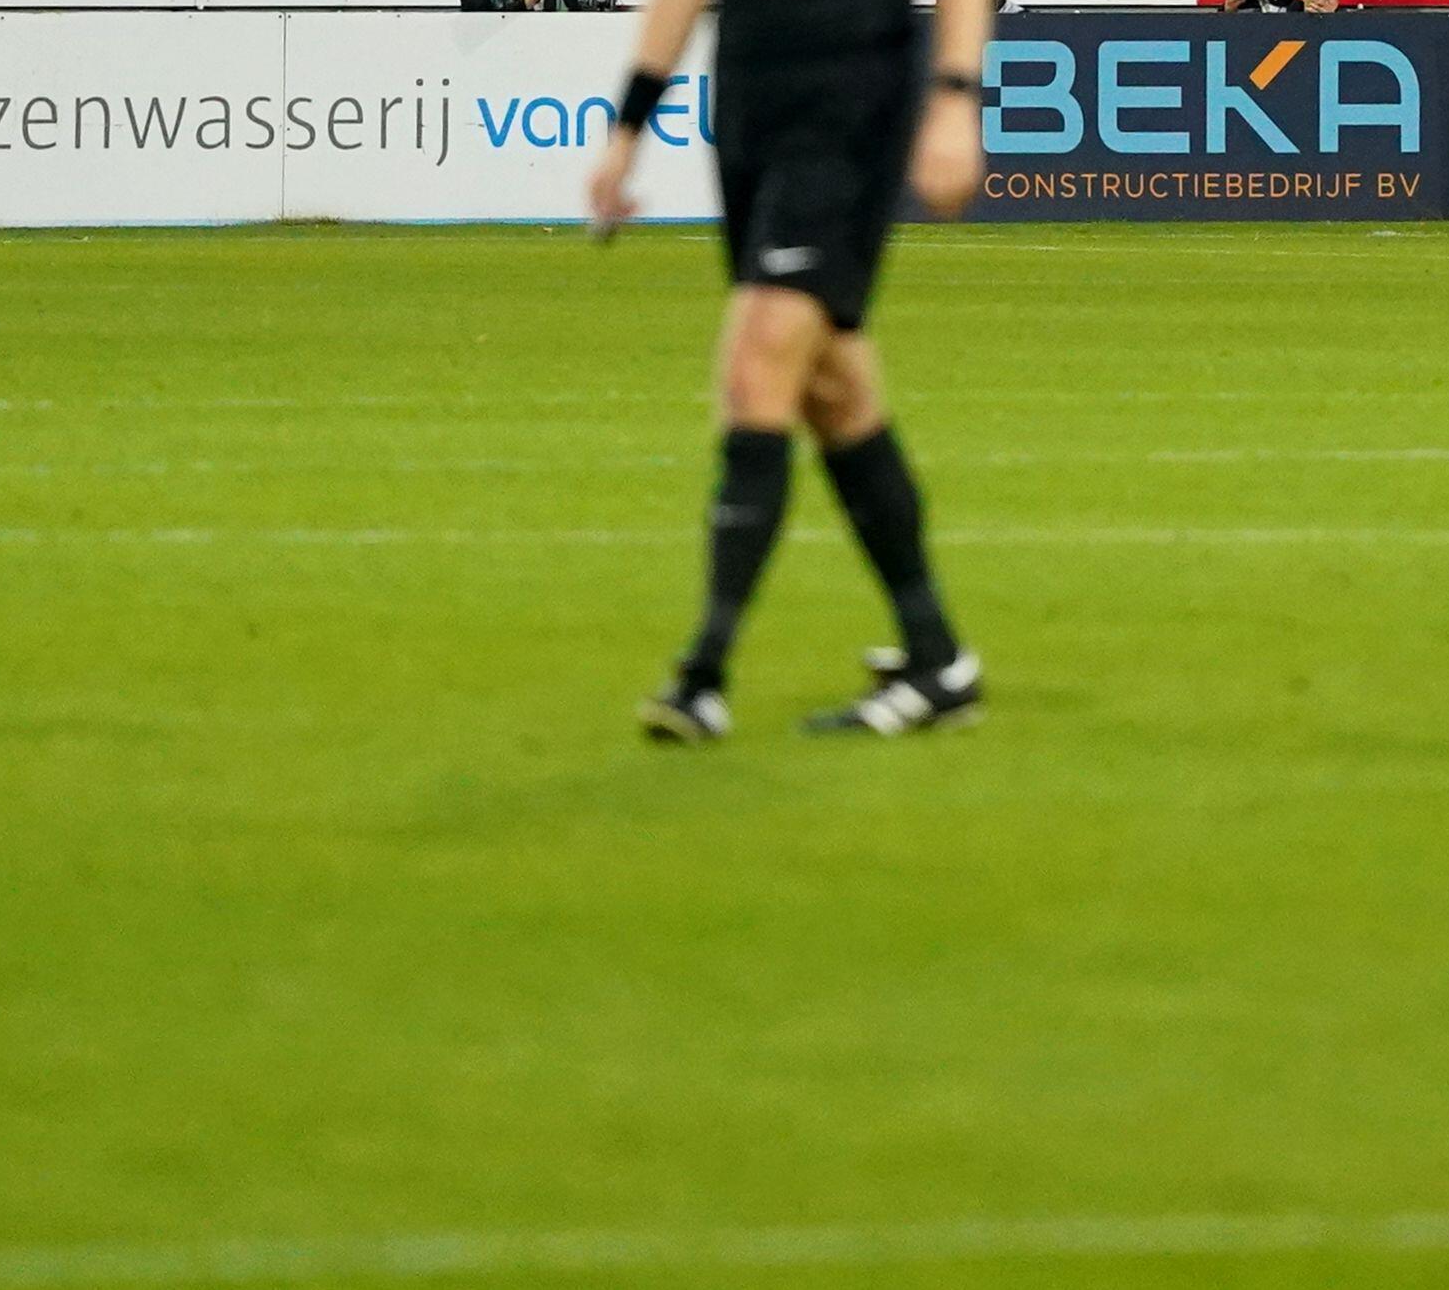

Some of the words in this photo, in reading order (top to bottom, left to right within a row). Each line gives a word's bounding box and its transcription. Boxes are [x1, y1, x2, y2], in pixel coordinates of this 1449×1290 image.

[476, 97, 618, 148] van
[982, 40, 1421, 154] BEKA
[983, 172, 1362, 199] CONSTRUCTIEBEDRIJF
[1378, 172, 1422, 199] BV
